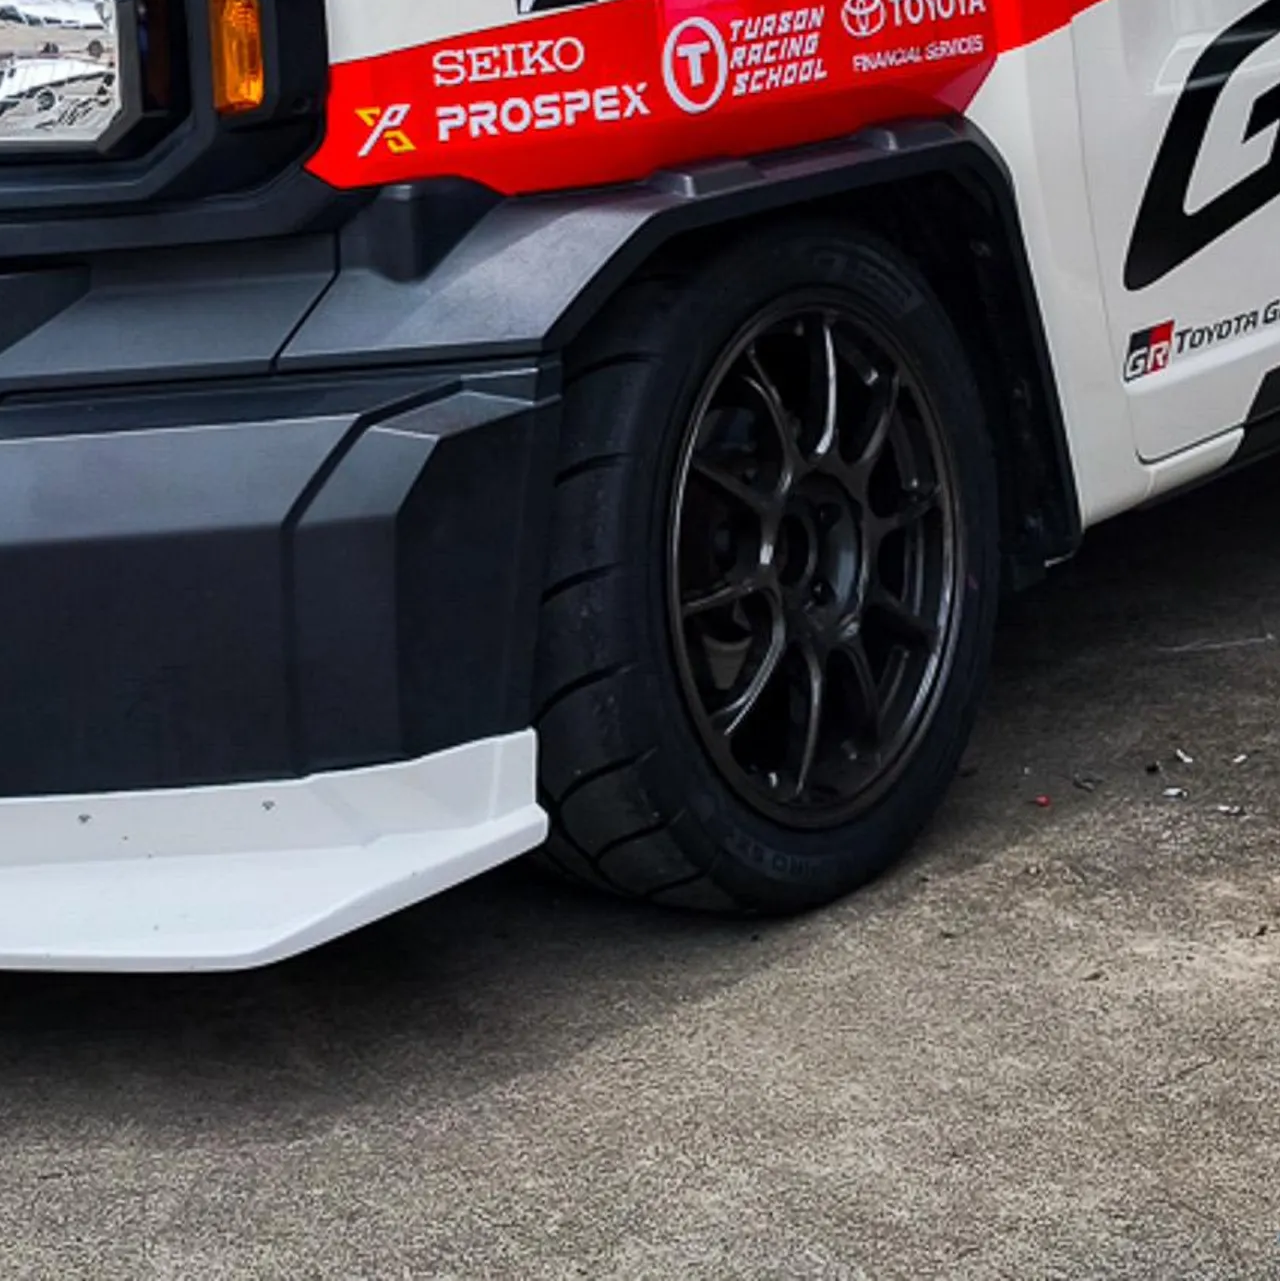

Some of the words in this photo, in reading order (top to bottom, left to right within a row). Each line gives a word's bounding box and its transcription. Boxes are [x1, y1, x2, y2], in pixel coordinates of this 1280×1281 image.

[432, 36, 585, 87] SEIKO
[730, 32, 820, 68] RACING
[852, 45, 923, 72] FINANCIAL
[924, 34, 984, 62] SERVICES
[733, 59, 828, 97] SCHOOL
[436, 81, 651, 142] PROSPEX
[1123, 342, 1170, 382] GR
[1174, 310, 1259, 354] TOYOTA
